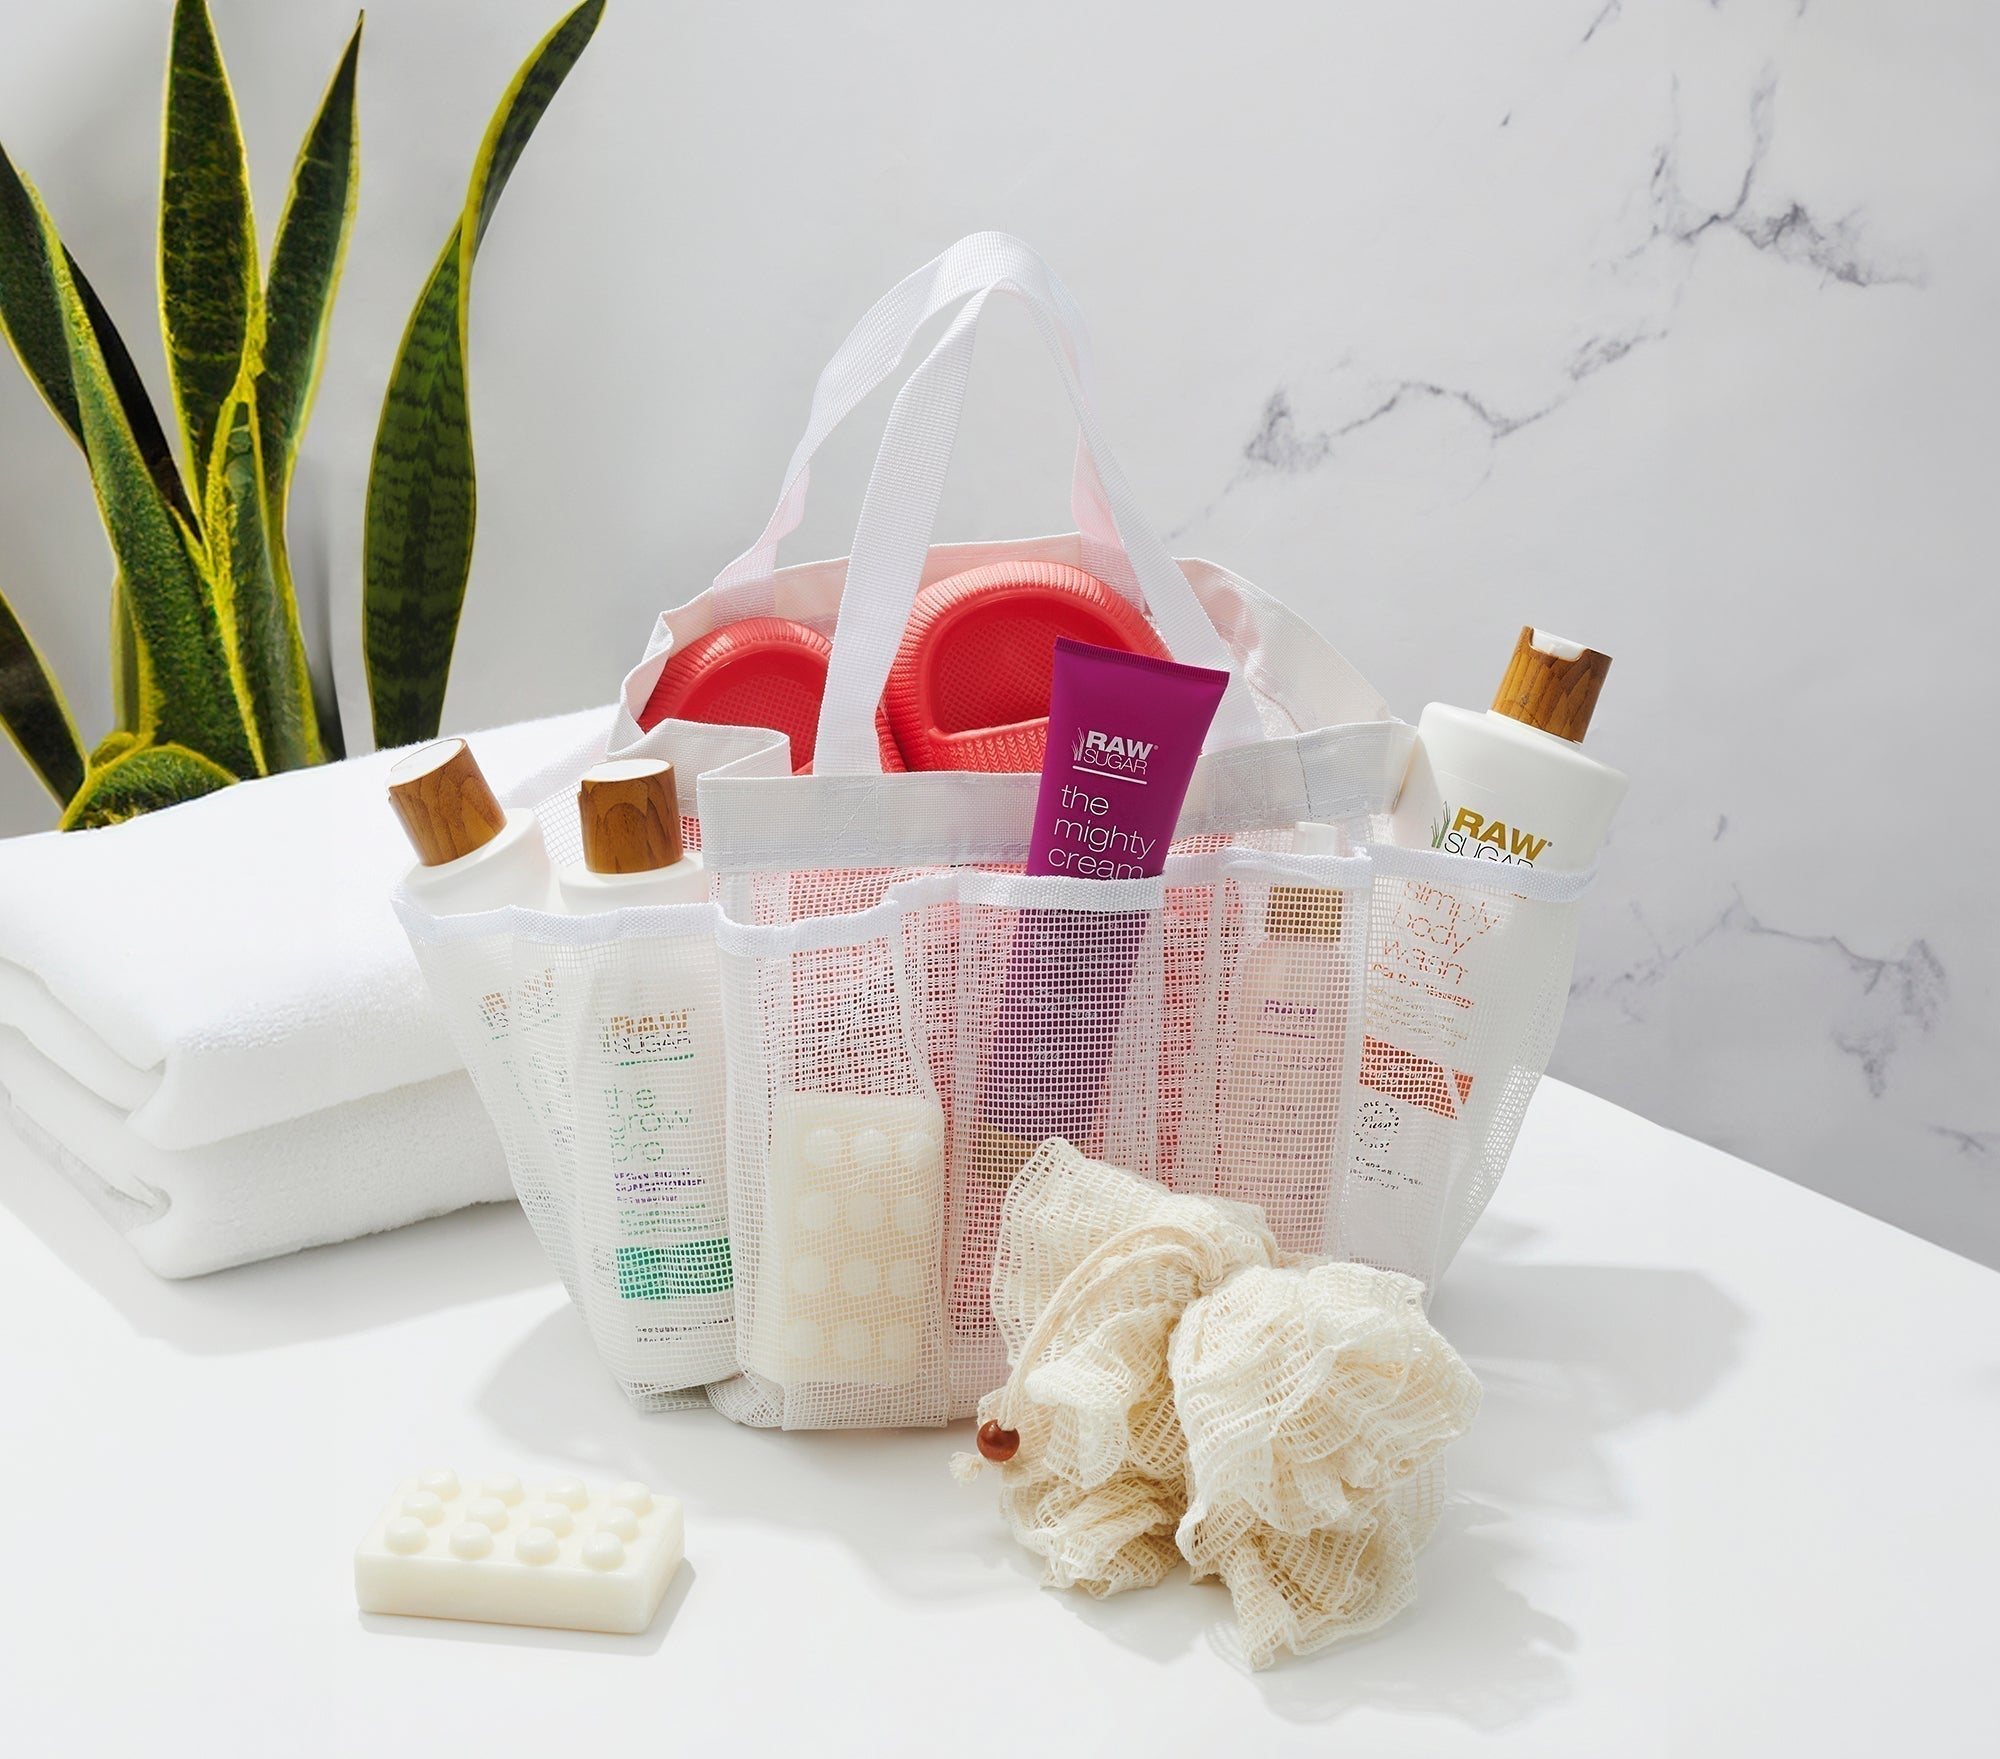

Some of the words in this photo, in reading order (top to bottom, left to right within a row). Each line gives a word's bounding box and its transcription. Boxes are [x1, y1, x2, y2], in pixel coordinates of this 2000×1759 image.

[1082, 748, 1148, 775] SUGAR
[1085, 730, 1154, 761] RAW
[1061, 784, 1109, 816] the
[1053, 818, 1157, 861] mighty
[1451, 807, 1548, 861] RAW
[1048, 847, 1144, 880] cream
